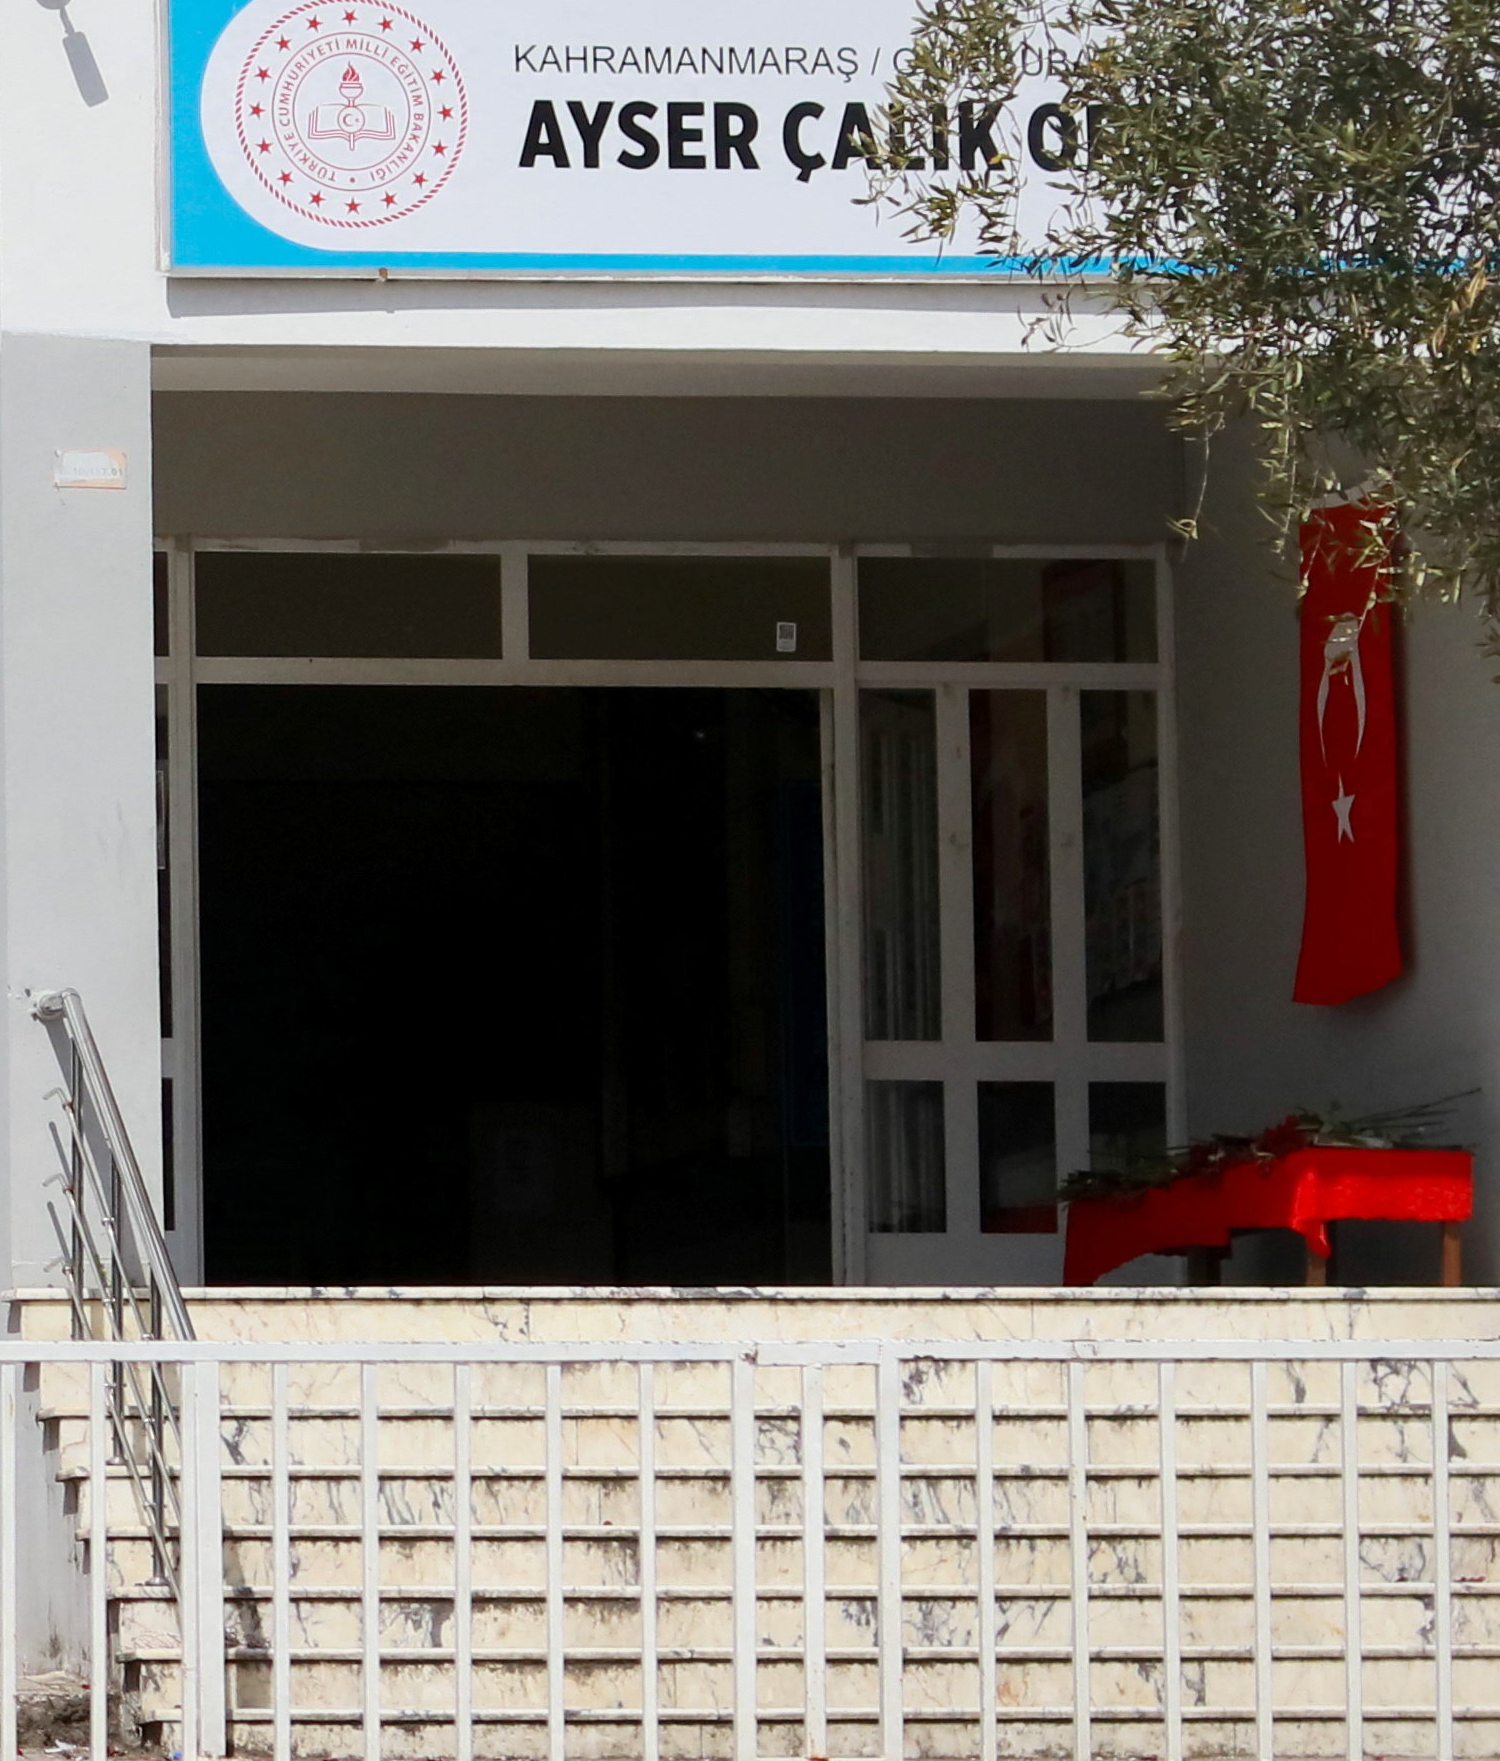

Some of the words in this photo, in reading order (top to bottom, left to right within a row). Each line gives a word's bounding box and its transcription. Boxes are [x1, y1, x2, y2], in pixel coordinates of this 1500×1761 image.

[278, 37, 341, 127] CUMHURİYETİ
[389, 55, 424, 107] EĞİTİM
[514, 44, 859, 84] KAHRAMANMARAŞ
[369, 112, 425, 182] BAKANLIĞI
[518, 99, 761, 170] AYSER
